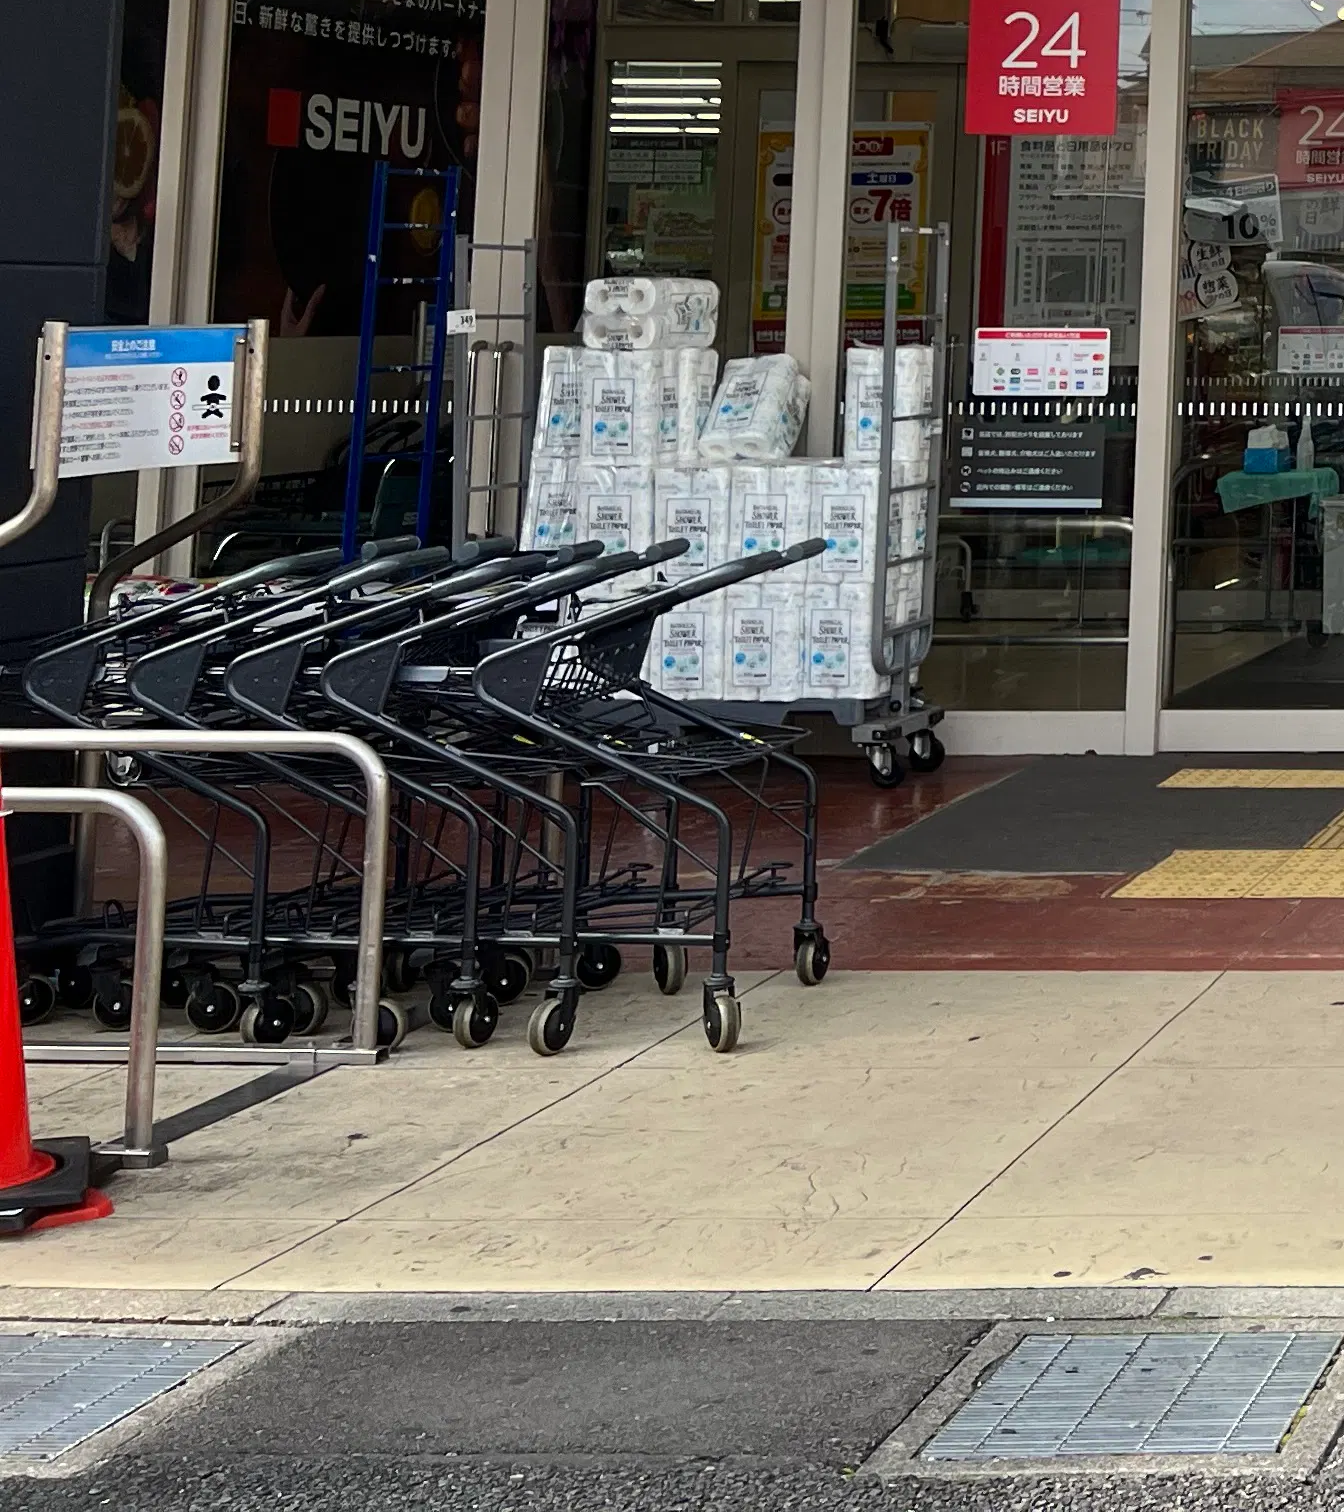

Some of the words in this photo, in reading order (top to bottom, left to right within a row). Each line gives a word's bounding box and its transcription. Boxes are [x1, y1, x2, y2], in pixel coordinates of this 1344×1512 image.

[1001, 11, 1087, 69] 24
[998, 75, 1086, 97] 時間営業
[304, 93, 427, 159] SEIYU
[1013, 108, 1070, 124] SEIYU
[1196, 119, 1265, 138] BLACK
